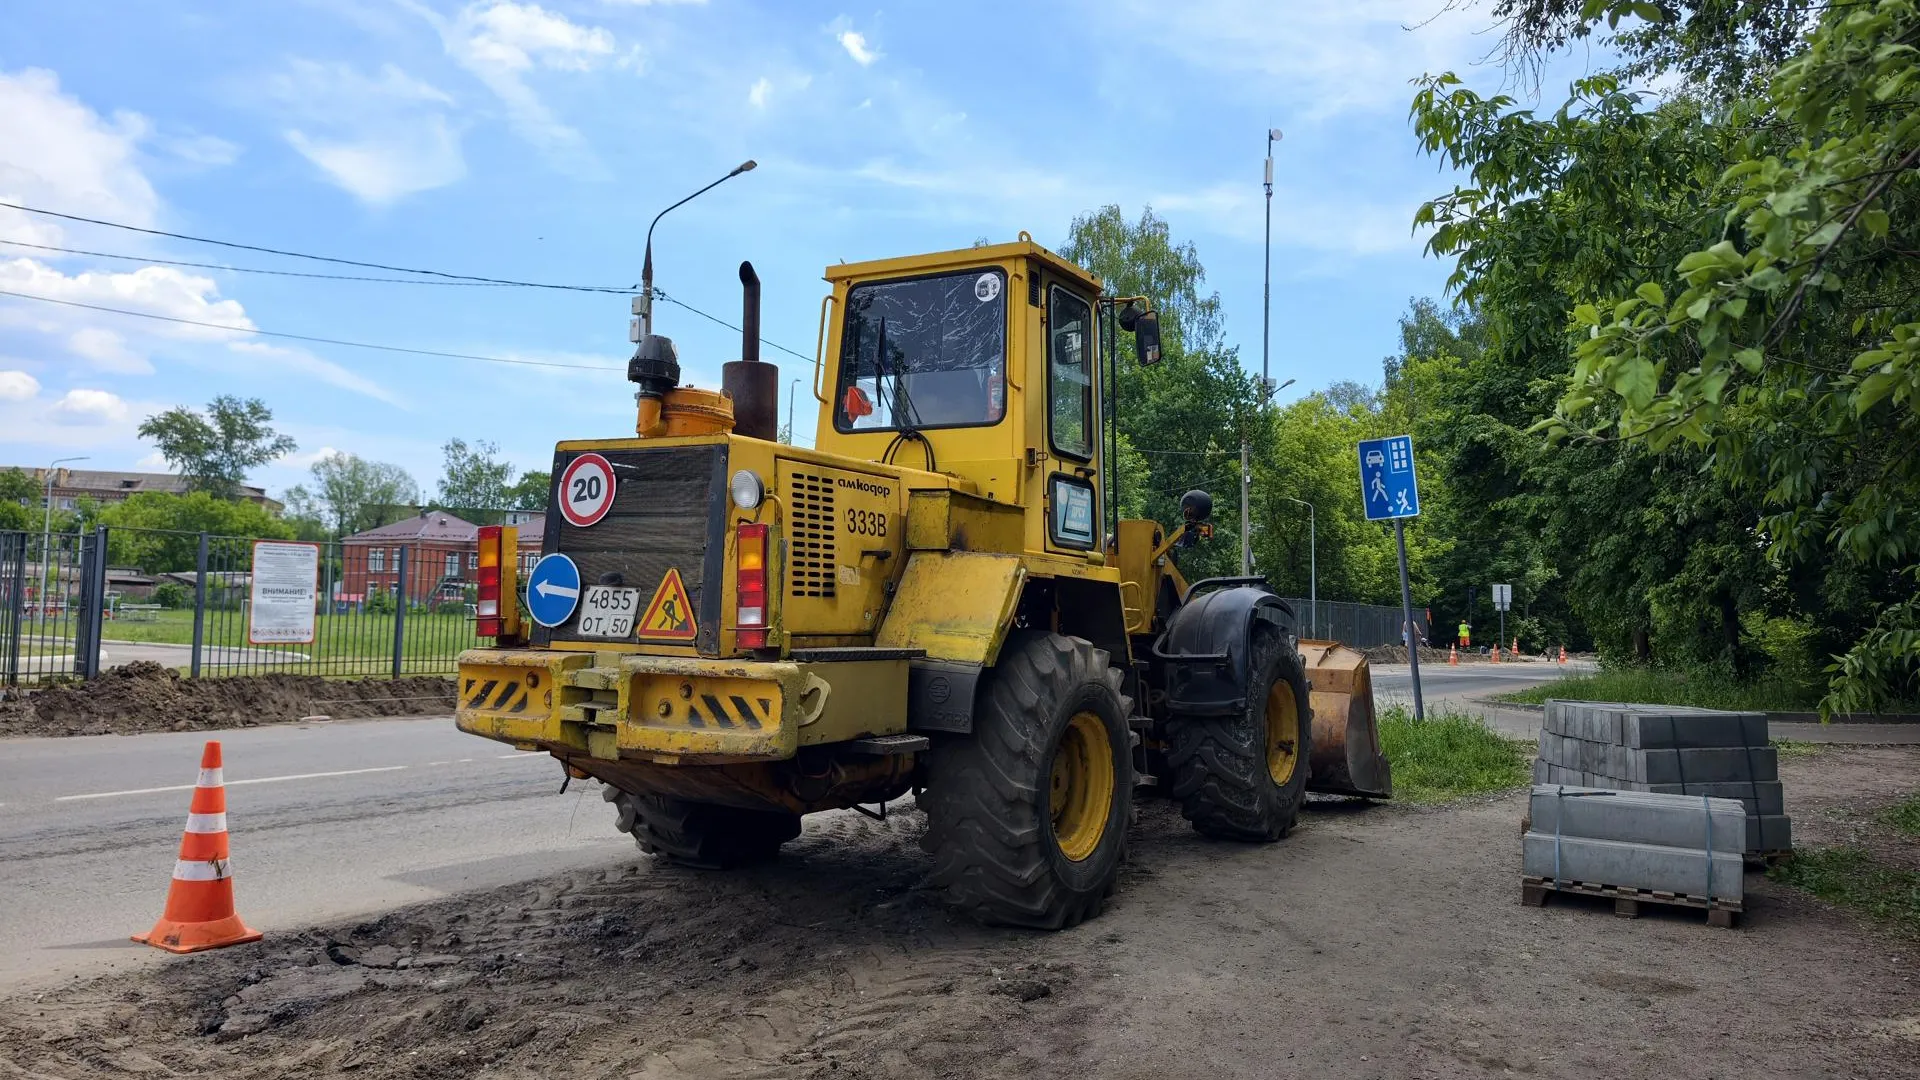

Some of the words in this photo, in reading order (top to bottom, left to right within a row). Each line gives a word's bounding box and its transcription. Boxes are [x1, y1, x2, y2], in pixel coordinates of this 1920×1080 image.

[572, 476, 602, 503] 20
[589, 589, 633, 610] 4855
[611, 618, 629, 634] 50
